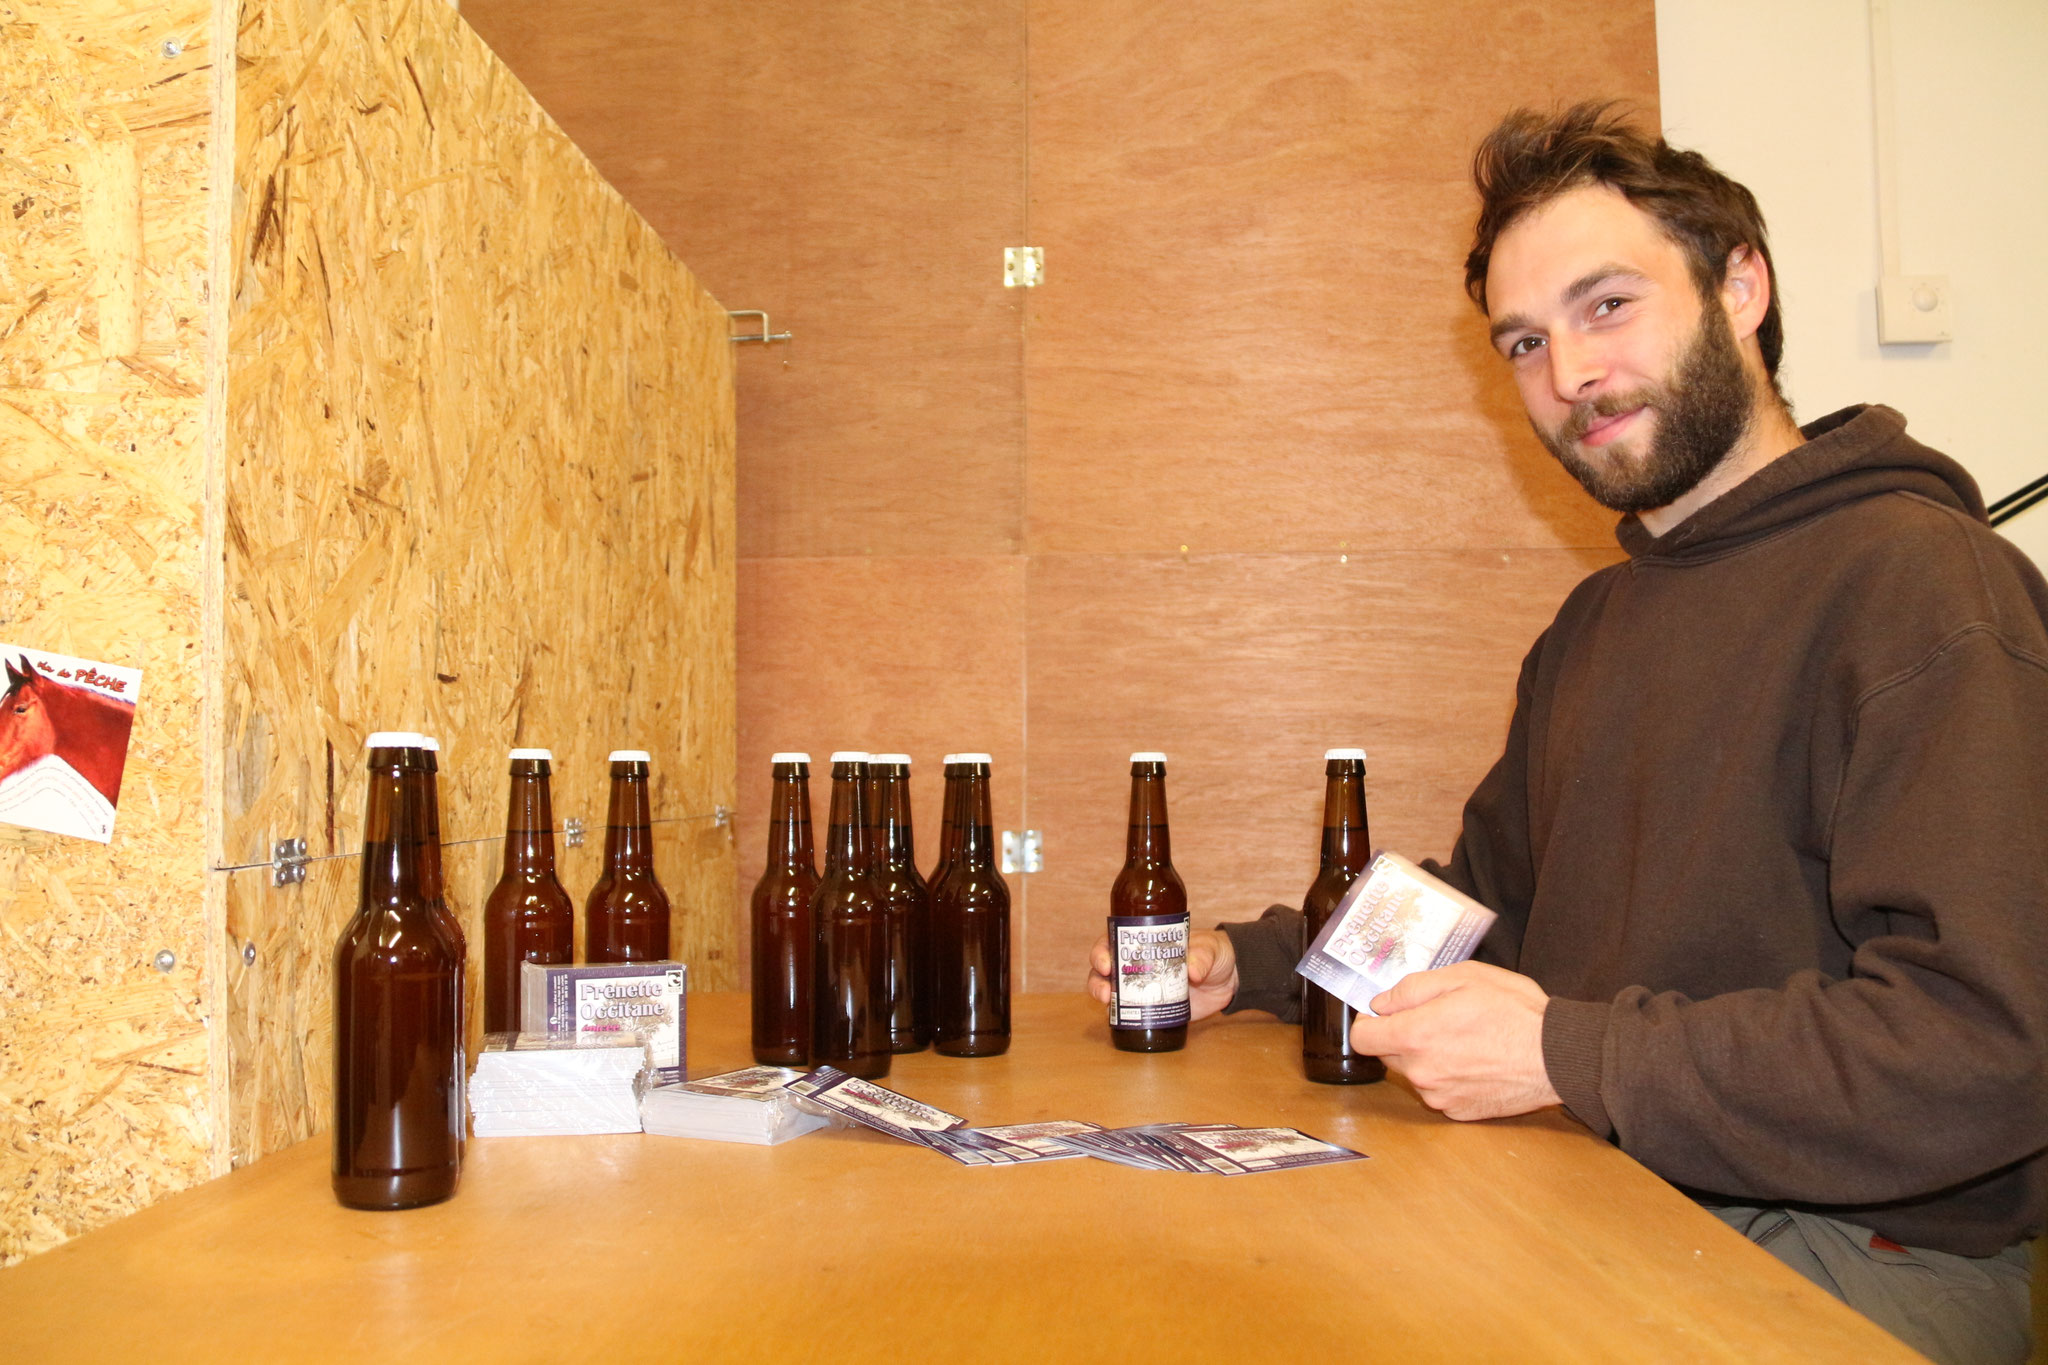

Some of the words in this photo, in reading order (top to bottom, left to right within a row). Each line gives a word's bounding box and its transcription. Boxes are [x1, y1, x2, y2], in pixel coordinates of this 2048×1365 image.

[75, 667, 128, 693] PÊCHE
[580, 981, 663, 1001] Frênette
[580, 1001, 665, 1021] Occitane
